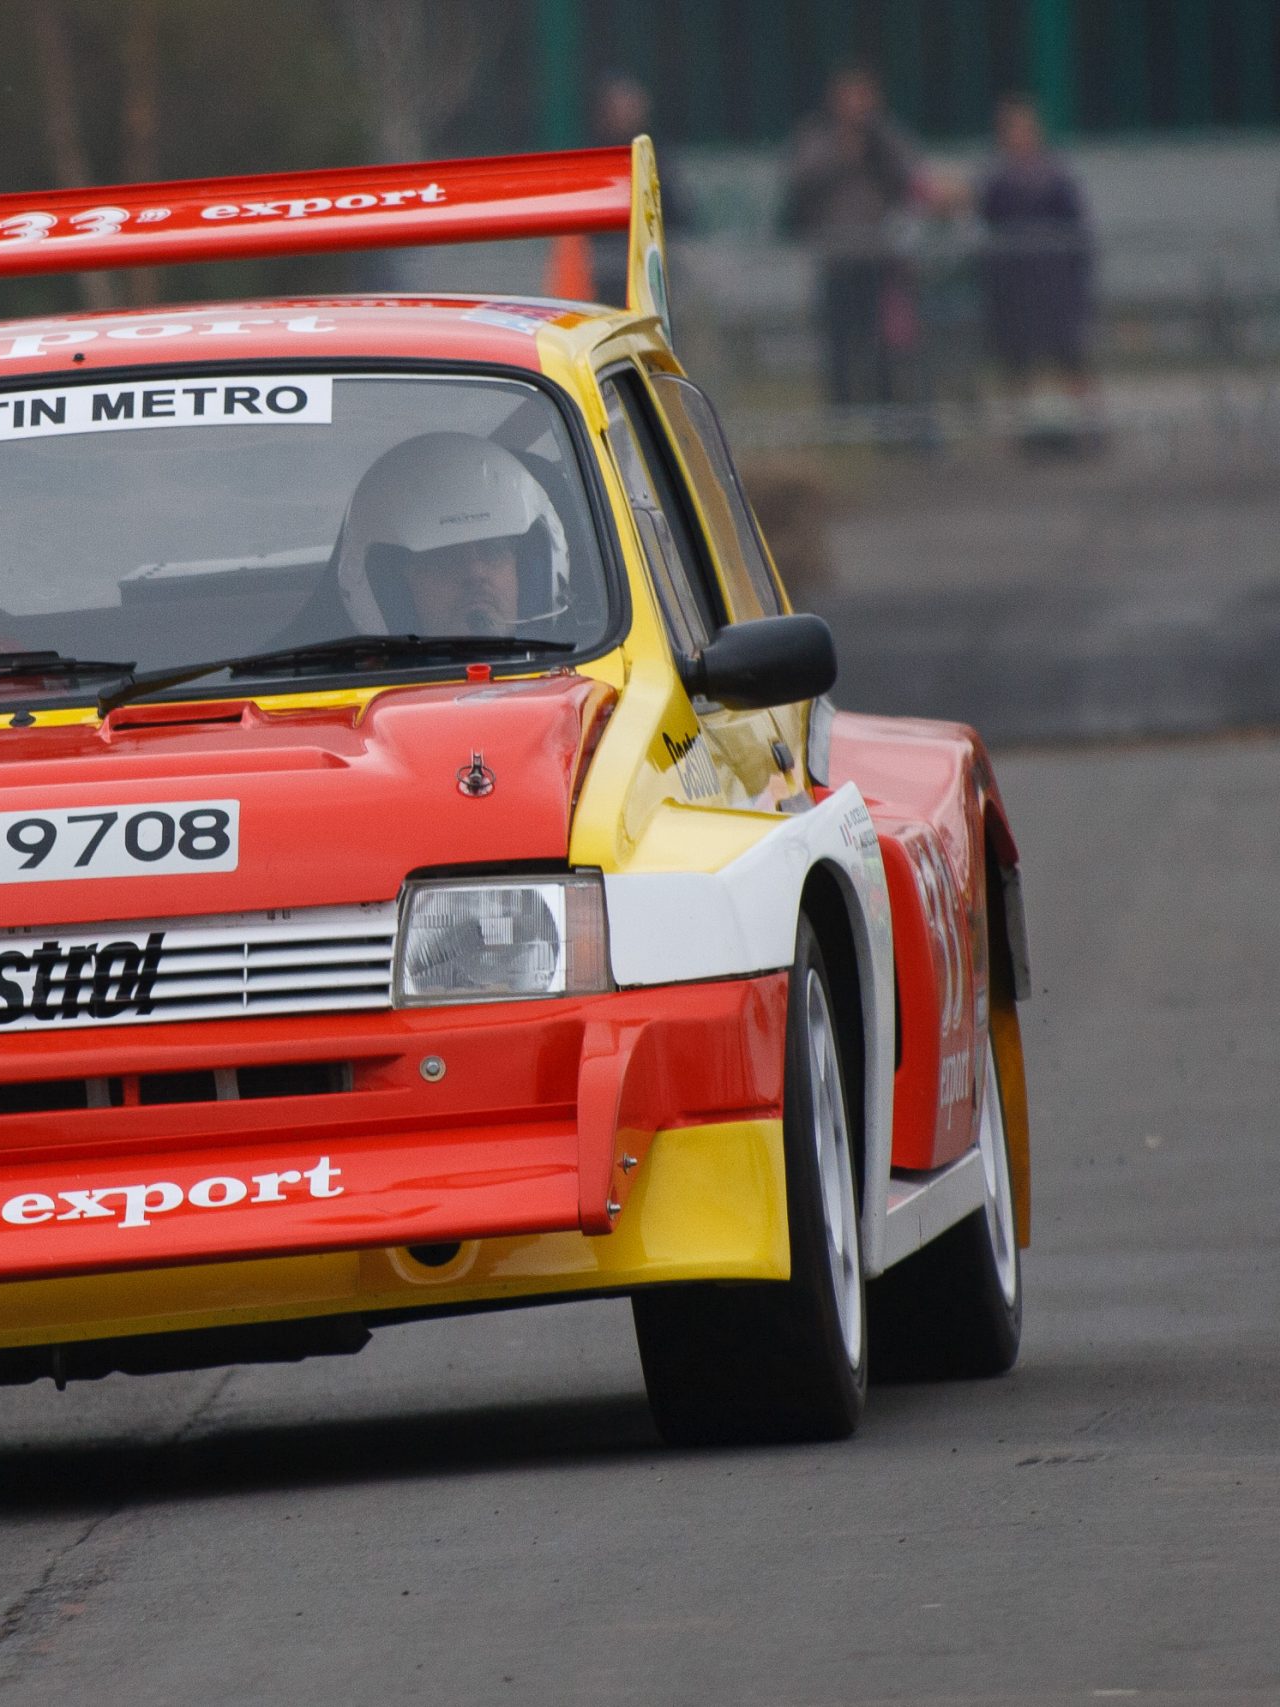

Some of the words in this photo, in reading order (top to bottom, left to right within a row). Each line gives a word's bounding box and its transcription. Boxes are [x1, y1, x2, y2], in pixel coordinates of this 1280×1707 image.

[201, 183, 447, 220] export
[91, 384, 309, 422] METRO
[6, 807, 231, 870] 9708
[1, 1155, 345, 1229] export
